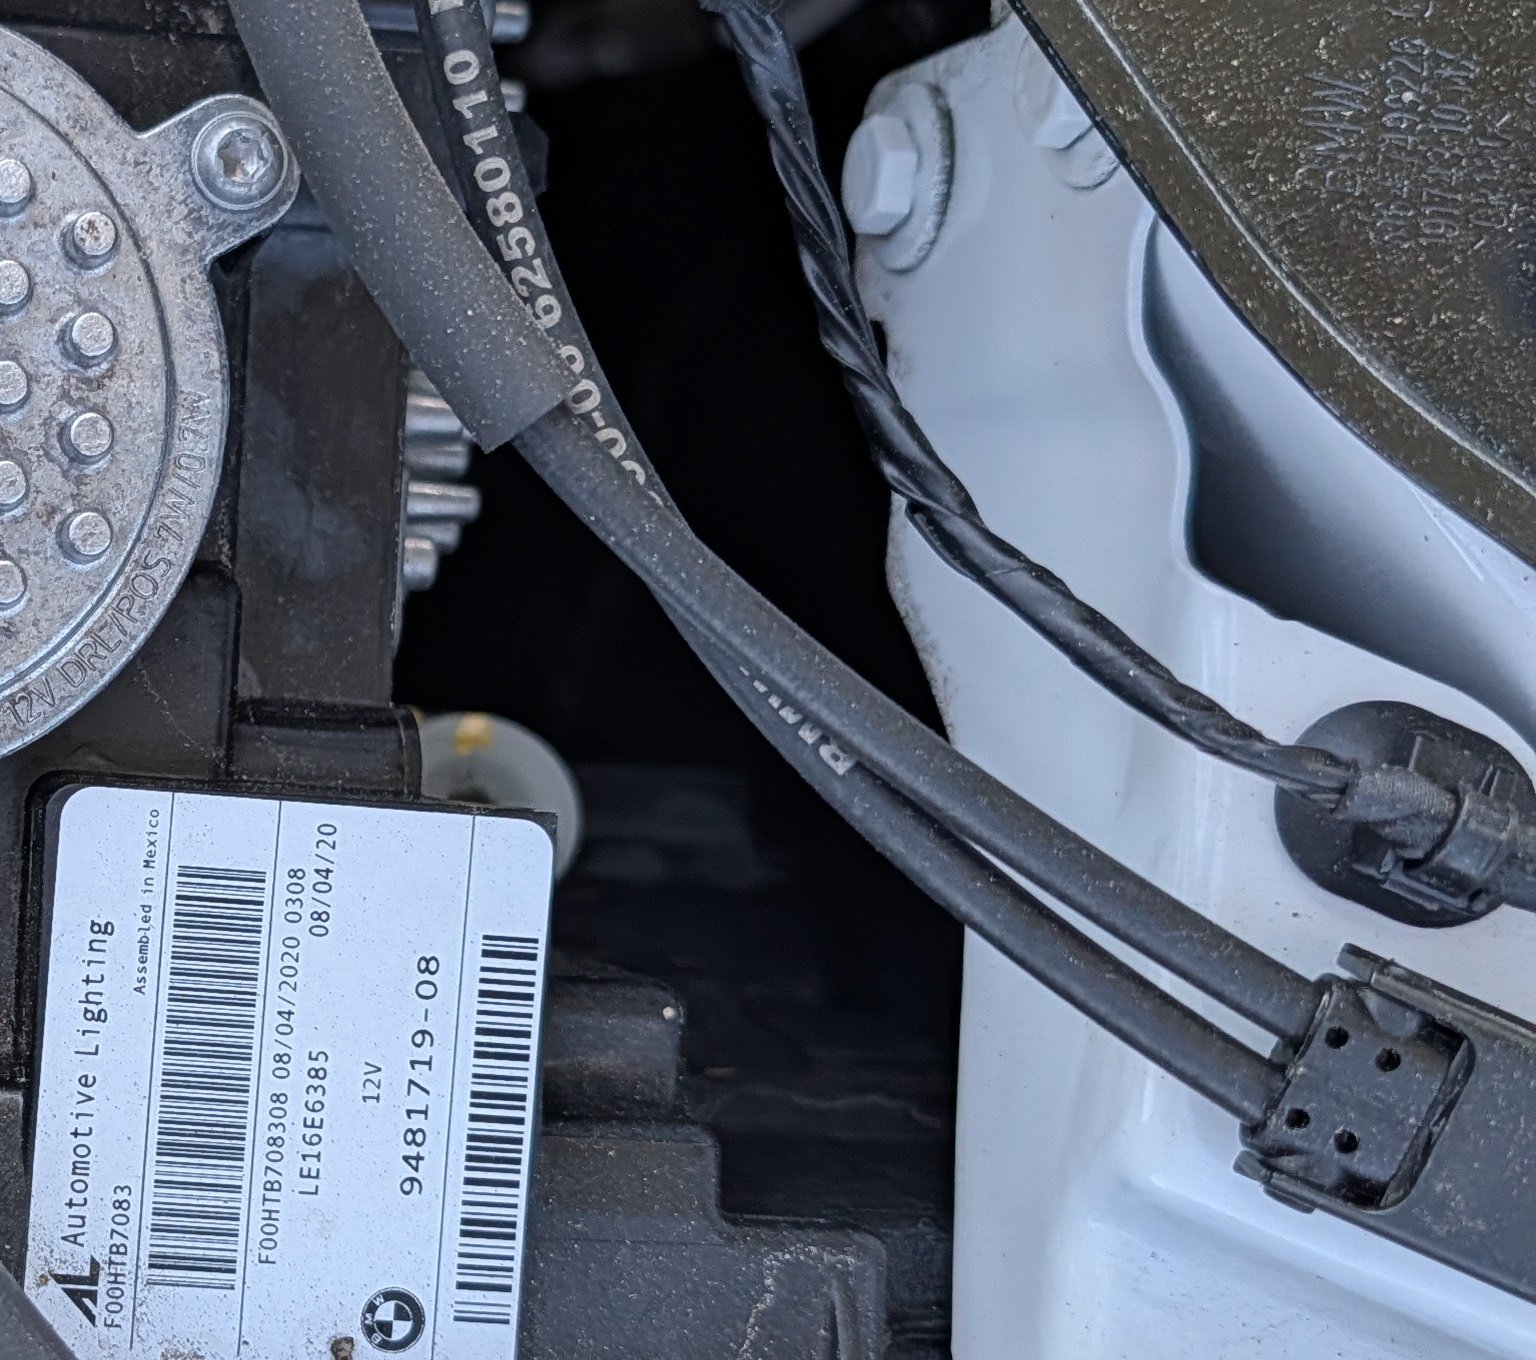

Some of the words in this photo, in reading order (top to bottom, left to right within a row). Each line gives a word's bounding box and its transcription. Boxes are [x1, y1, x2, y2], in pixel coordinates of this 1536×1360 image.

[441, 48, 563, 330] 62580110
[1, 677, 56, 727] 12V
[59, 549, 172, 688] DRL/POS
[142, 809, 160, 869] Mexico
[143, 876, 156, 896] in
[284, 868, 306, 924] 0308
[308, 823, 338, 938] 08/04/20
[73, 919, 115, 1056] Lighting
[132, 904, 153, 996] Assembled
[271, 936, 301, 1080] 08/04/2020
[298, 1050, 329, 1196] LE16E6385
[361, 1061, 382, 1104] 12V
[399, 955, 440, 1196] 9481719-08
[60, 1073, 97, 1248] Automotive
[257, 1092, 289, 1265] F00HTB708308
[103, 1184, 132, 1330] F00HTB7083
